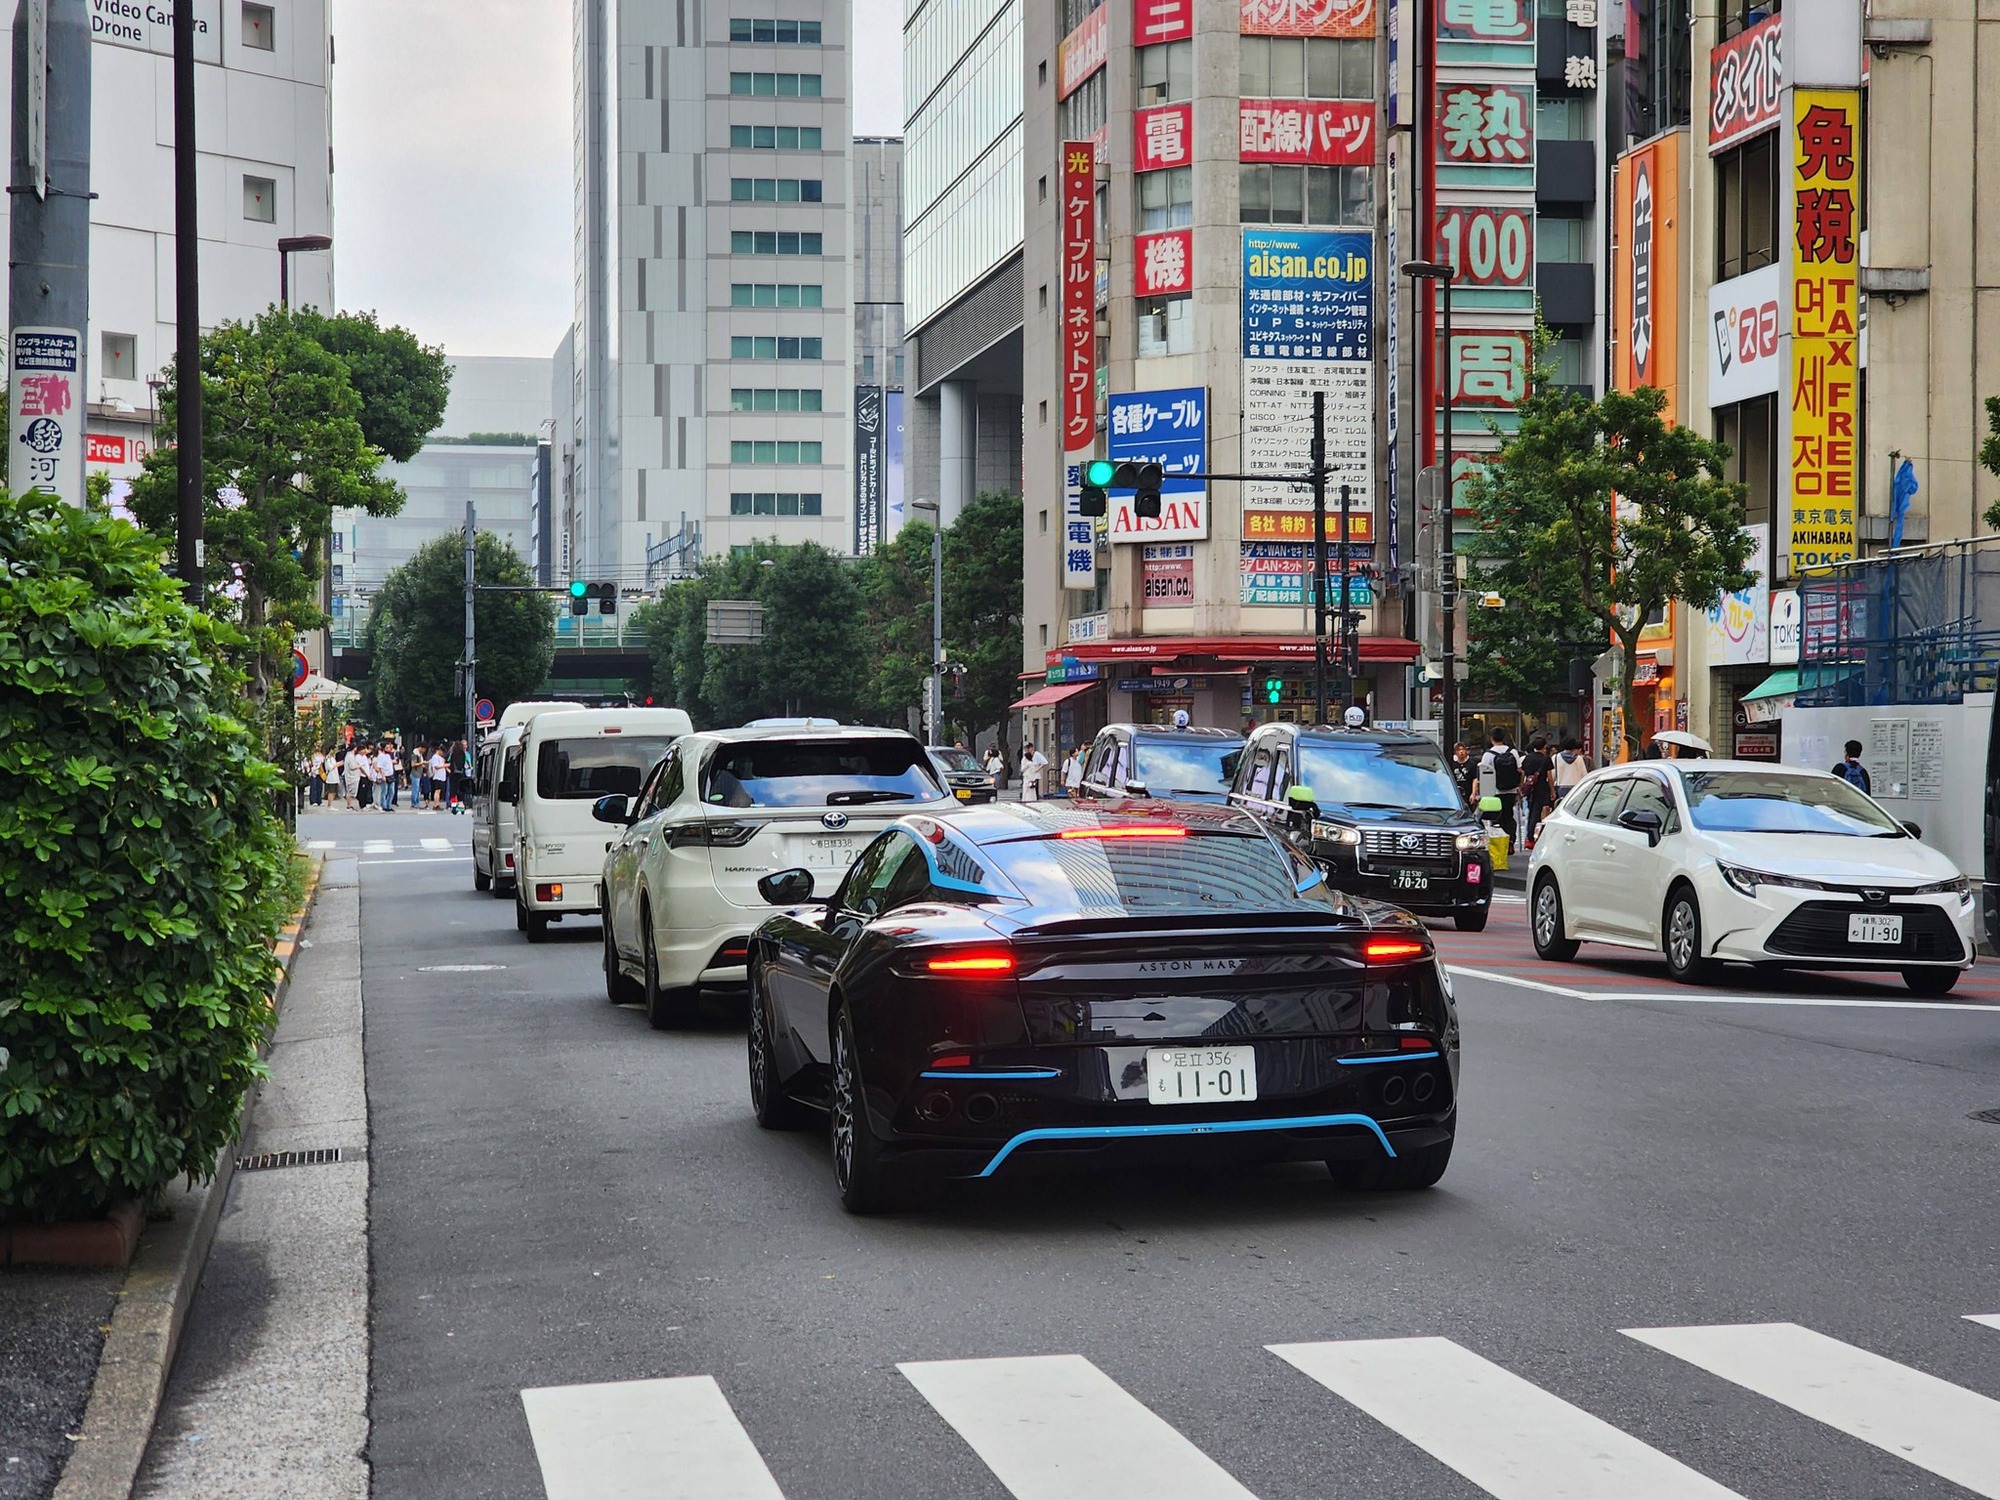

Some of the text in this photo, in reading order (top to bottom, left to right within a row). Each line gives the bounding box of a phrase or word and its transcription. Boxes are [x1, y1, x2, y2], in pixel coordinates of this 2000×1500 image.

[94, 0, 207, 33] Video Camra
[92, 15, 142, 41] Drone
[1241, 109, 1371, 154] 配線パーツ
[1797, 105, 1855, 264] 免税
[1248, 239, 1301, 250] http://www.
[1249, 250, 1367, 282] aisan.co.jp
[1827, 279, 1854, 496] TAX FREE
[1112, 399, 1201, 435] 各種ケーブル
[87, 439, 121, 459] Free
[1250, 515, 1275, 532] 各社
[1281, 515, 1306, 533] 特約
[1312, 517, 1336, 533] 庫
[1793, 509, 1852, 525] 東京電気
[1792, 531, 1853, 544] AKIHABARA
[836, 839, 853, 848] 338
[1398, 877, 1428, 889] 70-20
[1878, 917, 1892, 925] 302
[1862, 926, 1899, 942] 11-90
[1139, 961, 1192, 972] ASTON
[1174, 1051, 1232, 1067] 足立 356
[1177, 1069, 1246, 1098] 11-01
